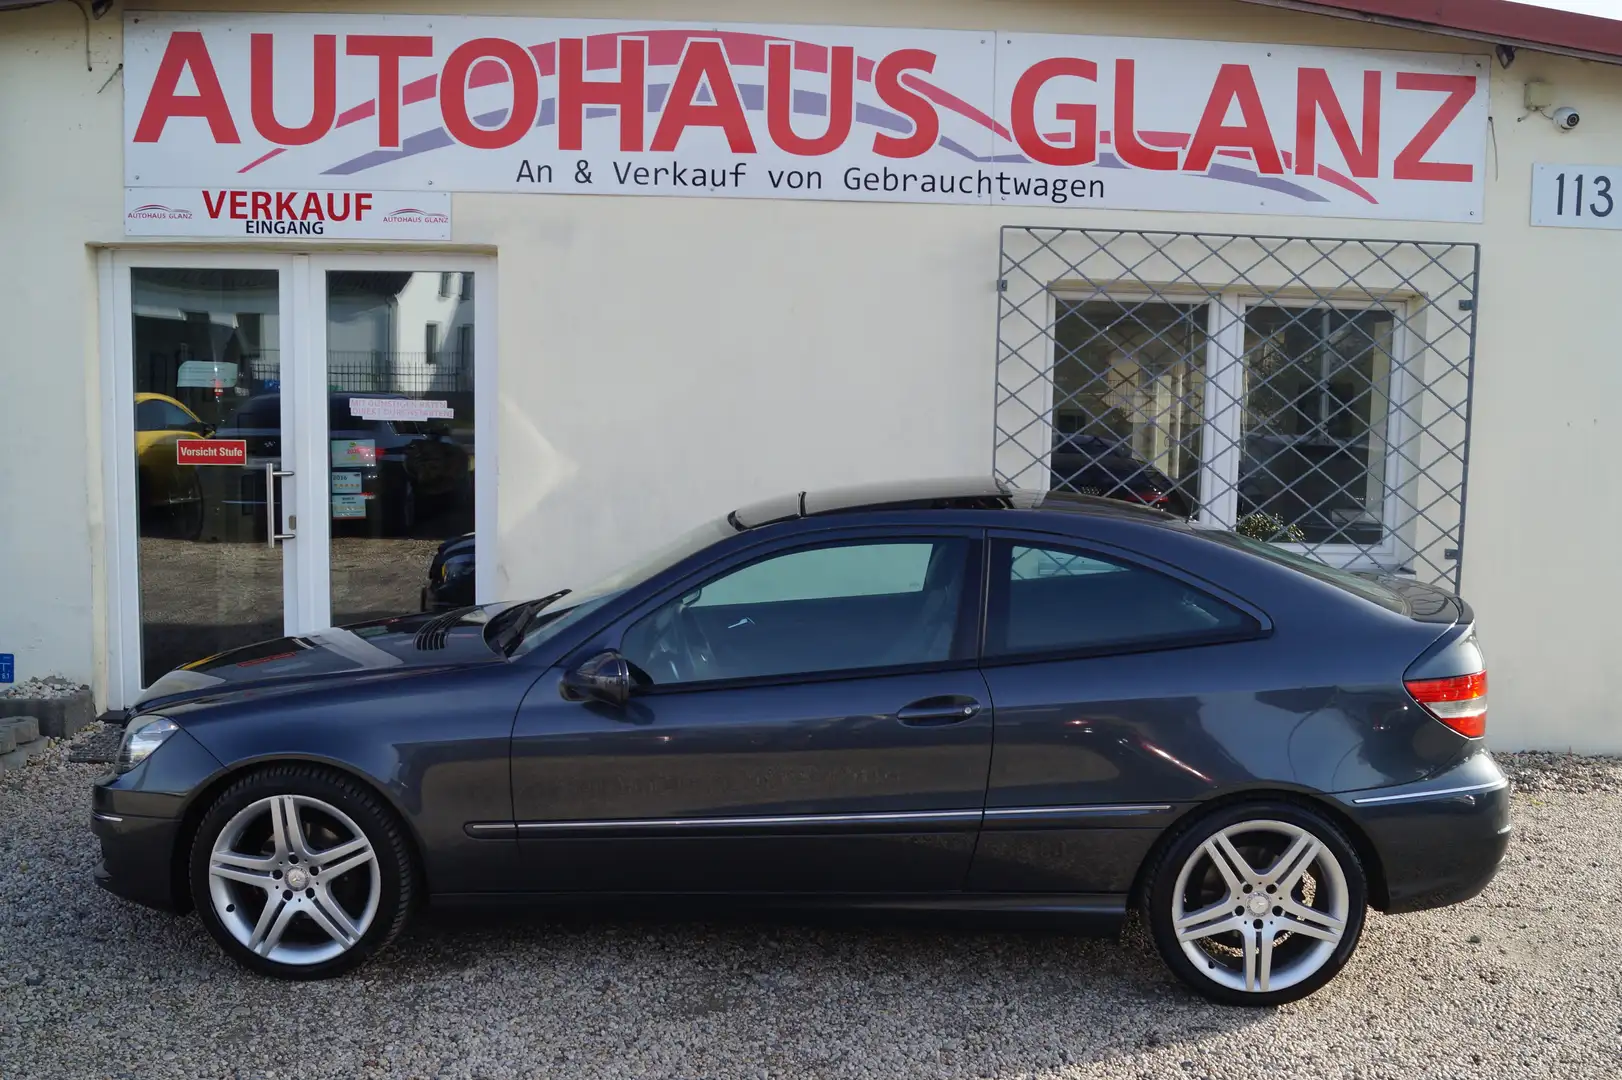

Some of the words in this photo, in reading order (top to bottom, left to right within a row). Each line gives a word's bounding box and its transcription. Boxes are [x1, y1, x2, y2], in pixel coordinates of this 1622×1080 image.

[133, 32, 939, 159] AUTOHAUS
[1010, 56, 1477, 183] GLANZ
[516, 159, 552, 183] An
[574, 160, 593, 184] &
[613, 161, 747, 188] Verkauf
[768, 169, 822, 189] von
[843, 167, 1105, 204] Gebrauchtwagen
[1555, 172, 1614, 218] 113
[202, 190, 373, 222] VERKAUF
[245, 220, 324, 235] EINGANG
[180, 446, 217, 457] Vorsicht
[219, 447, 243, 457] Stufe
